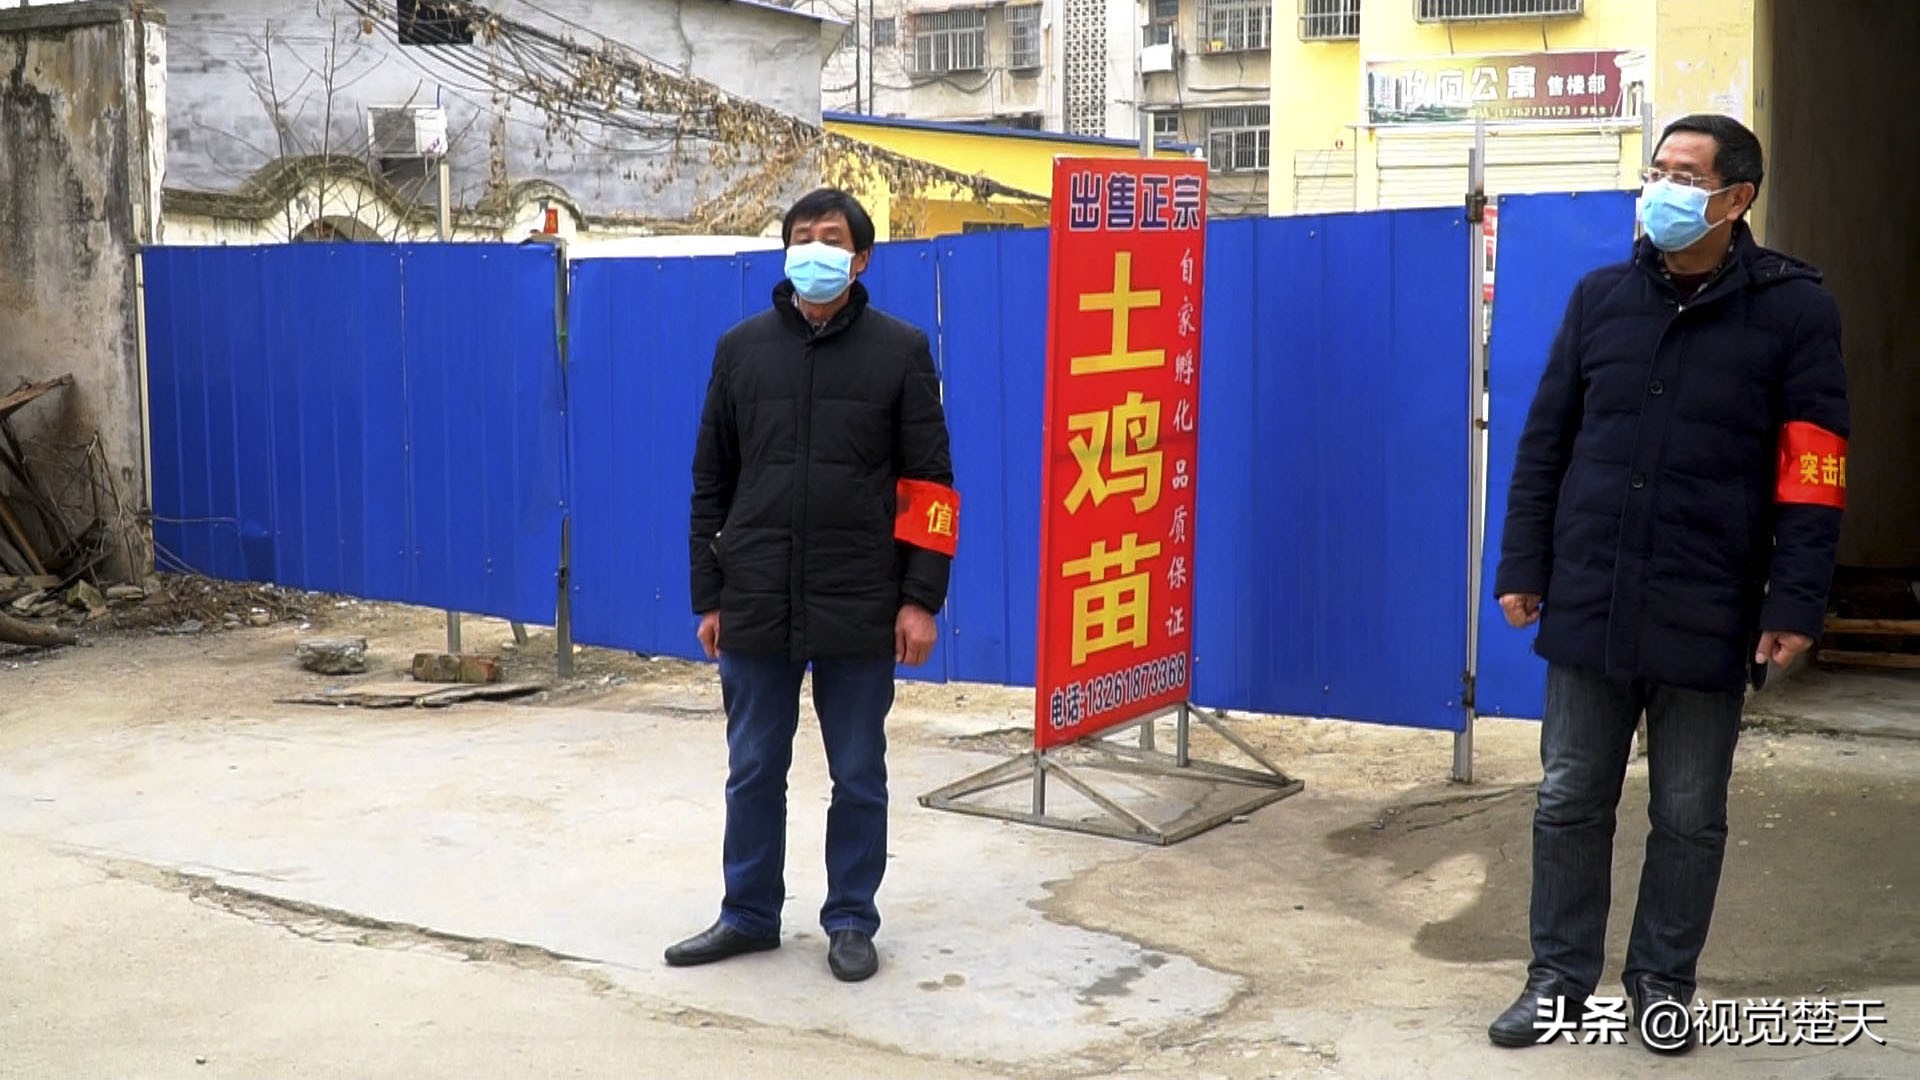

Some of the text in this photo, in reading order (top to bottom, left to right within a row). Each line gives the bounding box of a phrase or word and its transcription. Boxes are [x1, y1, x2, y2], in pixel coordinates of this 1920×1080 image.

[1547, 73, 1606, 97] 售楼部
[1068, 171, 1201, 231] 出售正宗
[1062, 251, 1166, 667] 土鸡苗
[926, 500, 953, 537] 值
